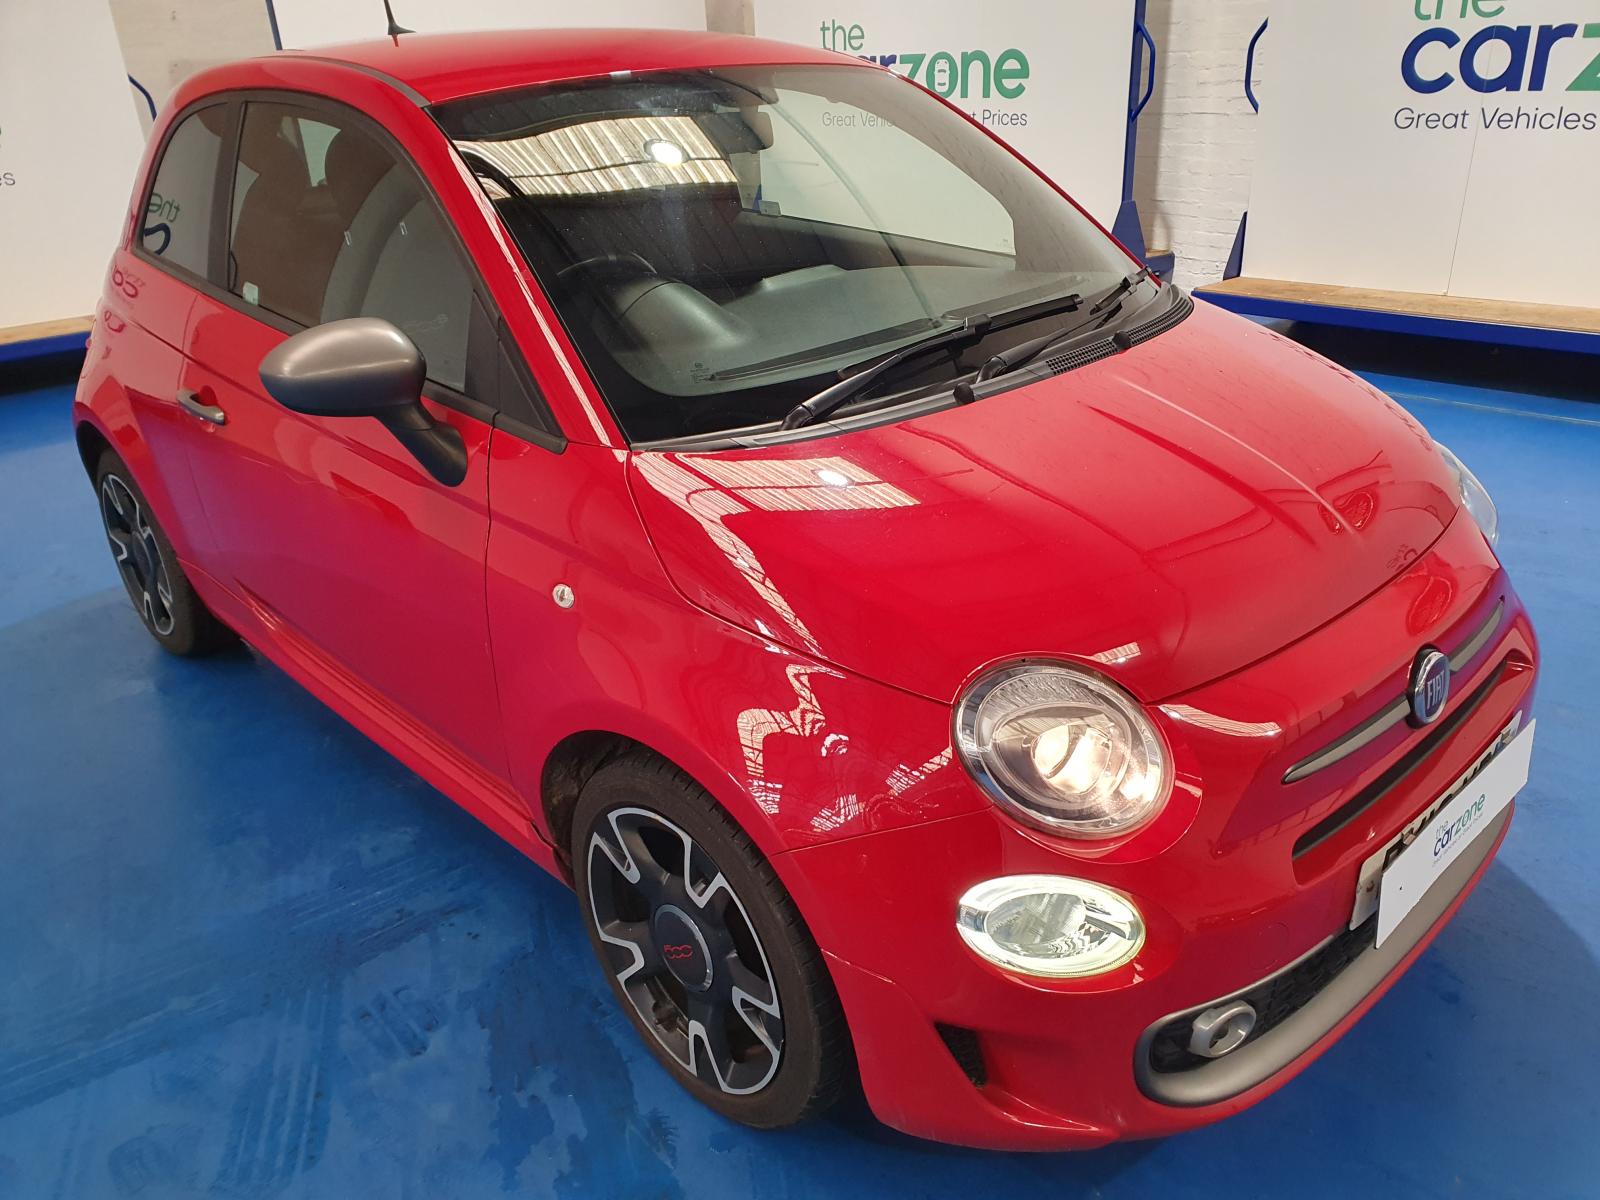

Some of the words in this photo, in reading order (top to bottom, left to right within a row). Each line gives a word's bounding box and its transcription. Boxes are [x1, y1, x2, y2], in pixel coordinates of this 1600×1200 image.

[820, 19, 864, 51] the
[857, 48, 1030, 99] zone
[822, 111, 856, 127] Great
[982, 109, 1028, 126] Prices
[1394, 107, 1470, 129] Great
[1481, 106, 1597, 130] Vehicles
[1427, 670, 1445, 710] FIAT
[1433, 793, 1486, 857] carzone
[663, 944, 694, 960] 500
